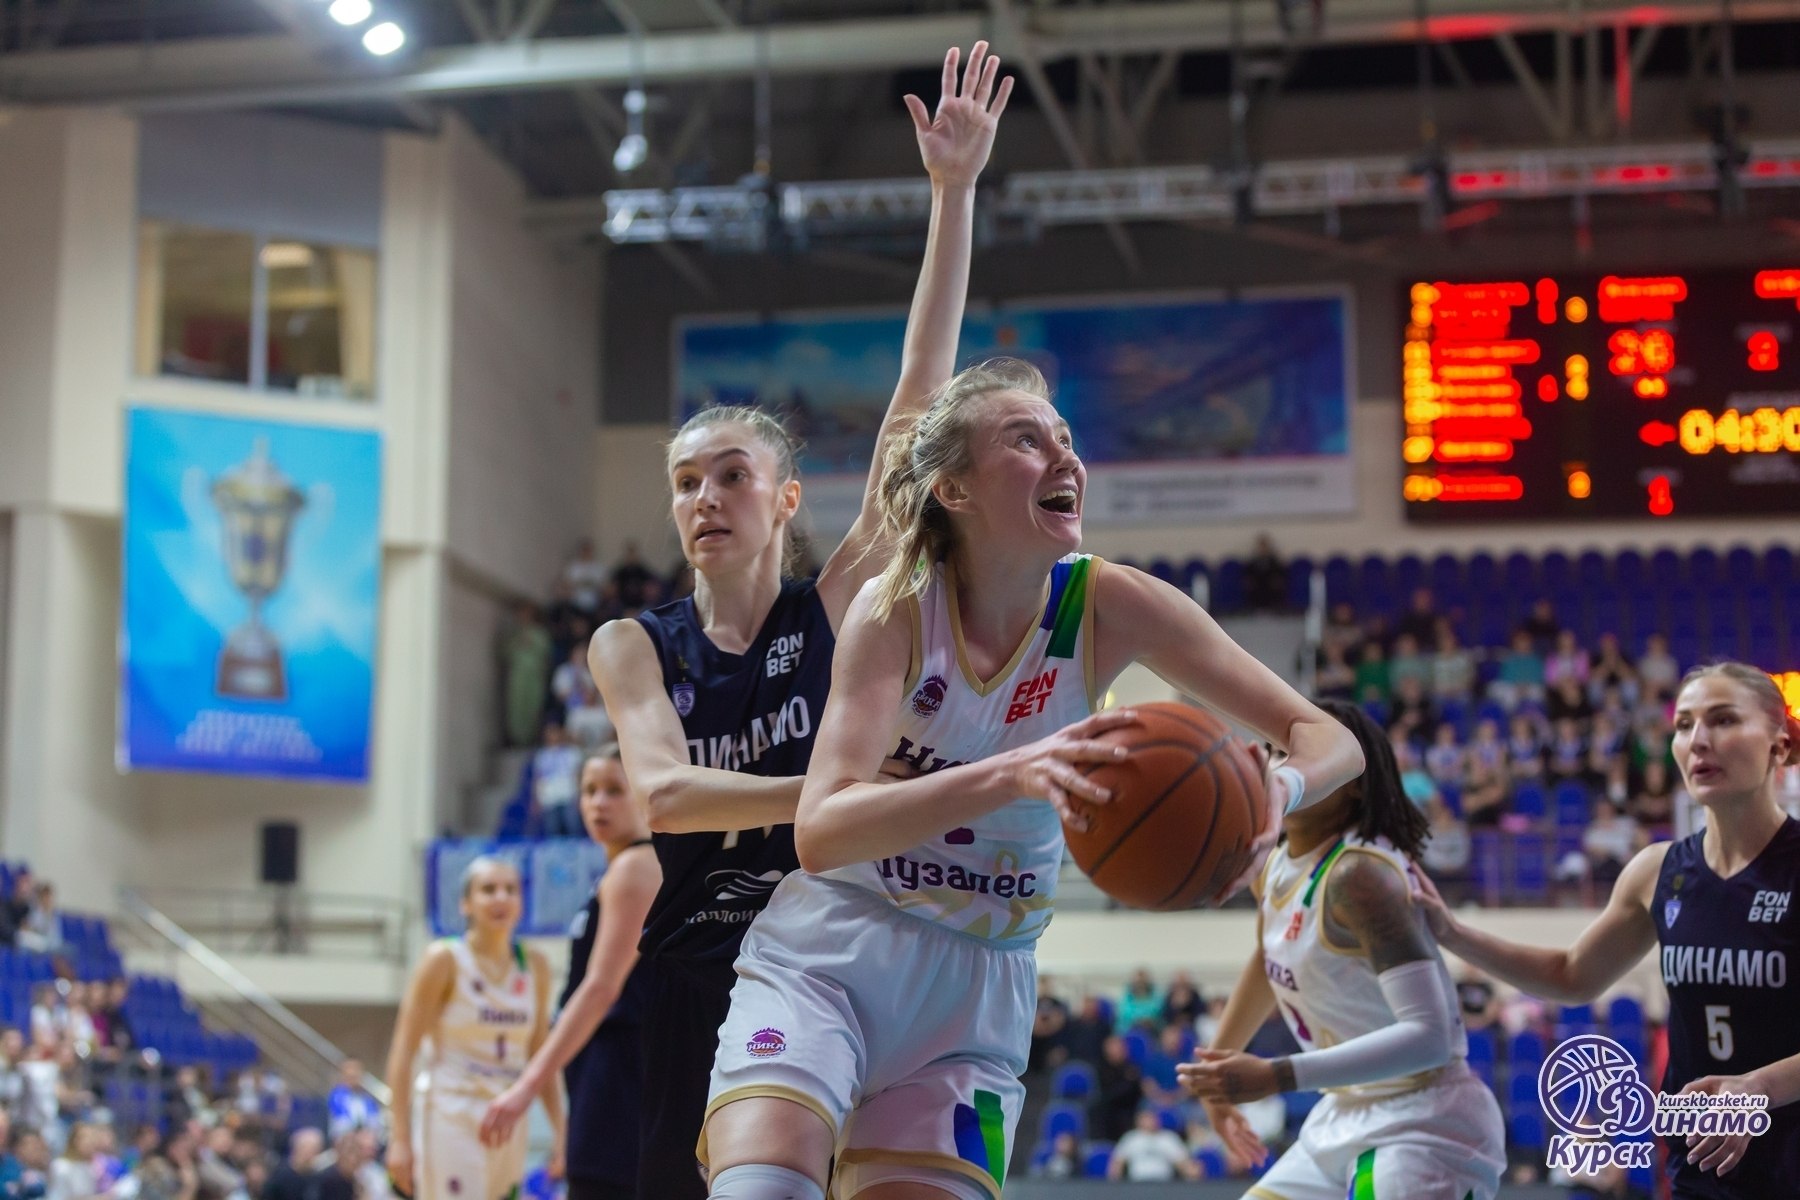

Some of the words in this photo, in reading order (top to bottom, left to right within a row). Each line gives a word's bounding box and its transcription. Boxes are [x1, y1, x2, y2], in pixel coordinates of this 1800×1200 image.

[766, 632, 803, 659] FON
[766, 650, 803, 678] BET
[1012, 668, 1058, 702] FON
[1004, 691, 1053, 724] BET
[1752, 890, 1791, 908] FON
[1748, 906, 1787, 923] BET
[1663, 945, 1787, 988] ДИНАМО
[1705, 1004, 1735, 1061] 5
[748, 1042, 786, 1052] НИКА
